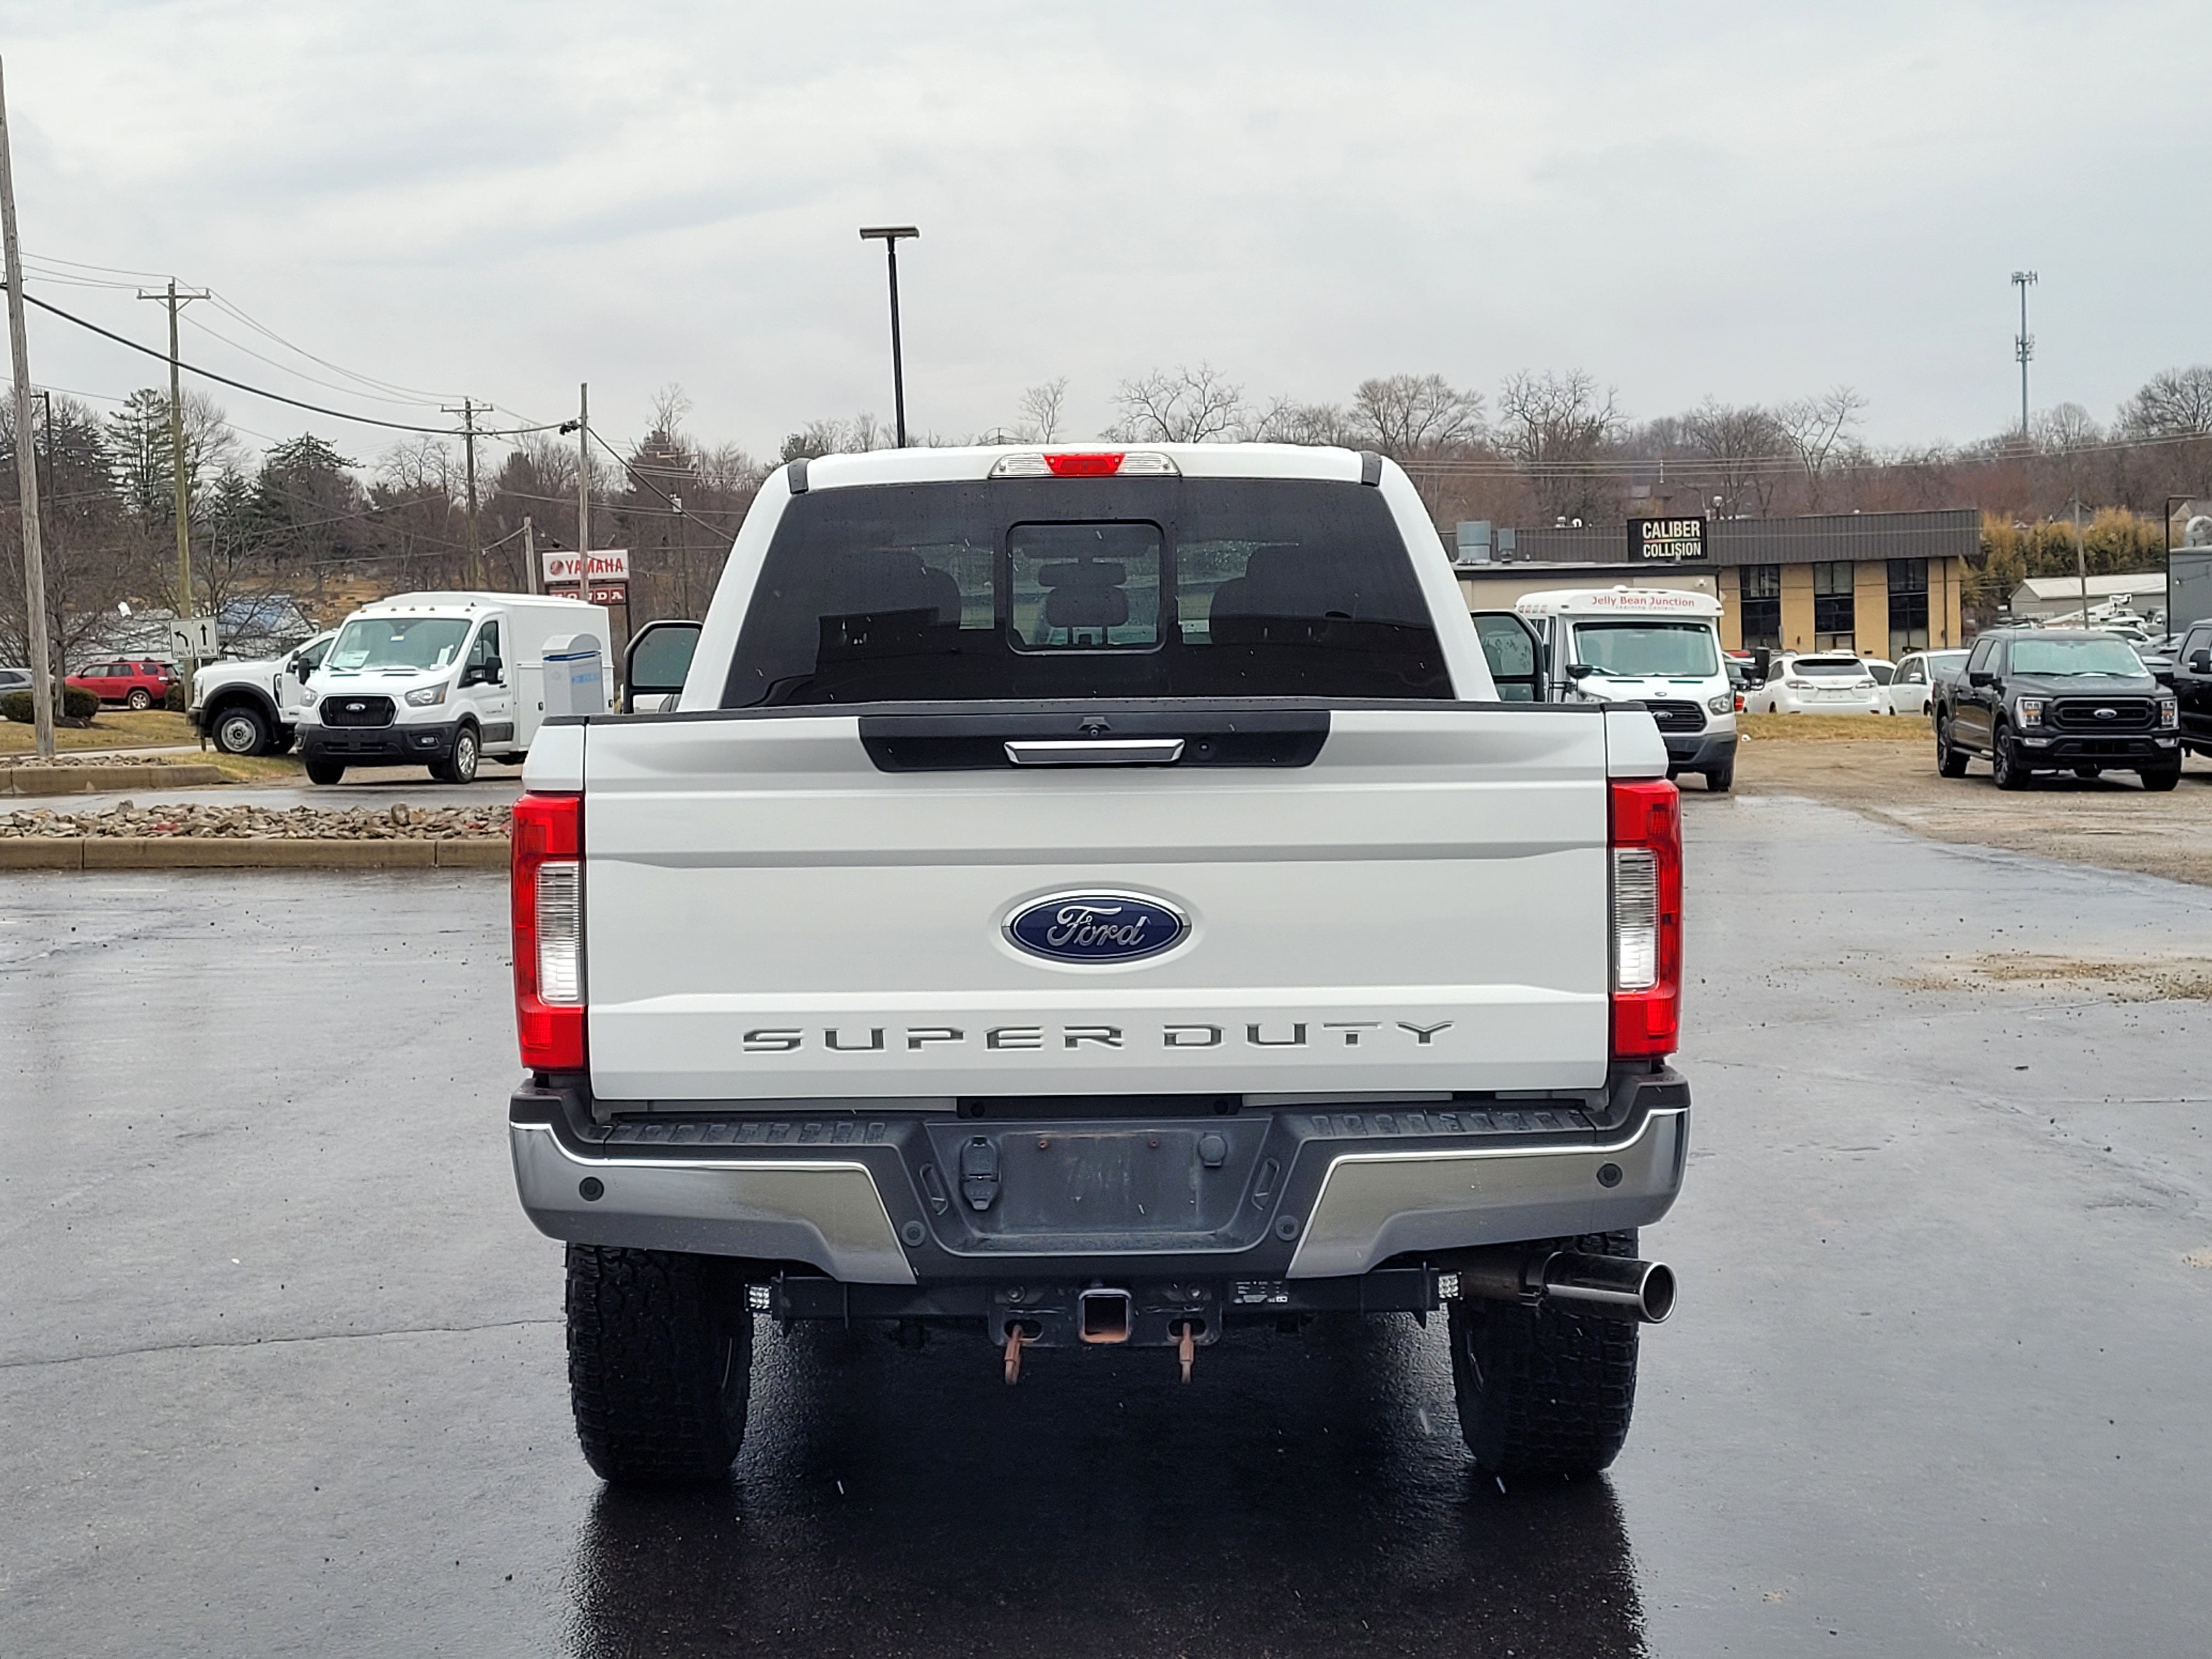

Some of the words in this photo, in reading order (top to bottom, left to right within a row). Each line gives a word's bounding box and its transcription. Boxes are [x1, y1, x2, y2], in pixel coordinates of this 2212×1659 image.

[1643, 521, 1701, 539] CALIBER
[1643, 542, 1701, 558] COLLISION
[566, 558, 624, 574] YAMAHA
[1592, 596, 1617, 606] Jelly
[1620, 596, 1646, 605] Bean
[1650, 596, 1695, 607] Junction
[1046, 905, 1150, 946] Ford
[743, 1026, 1124, 1052] SUPER
[1163, 1021, 1454, 1049] DUTY
